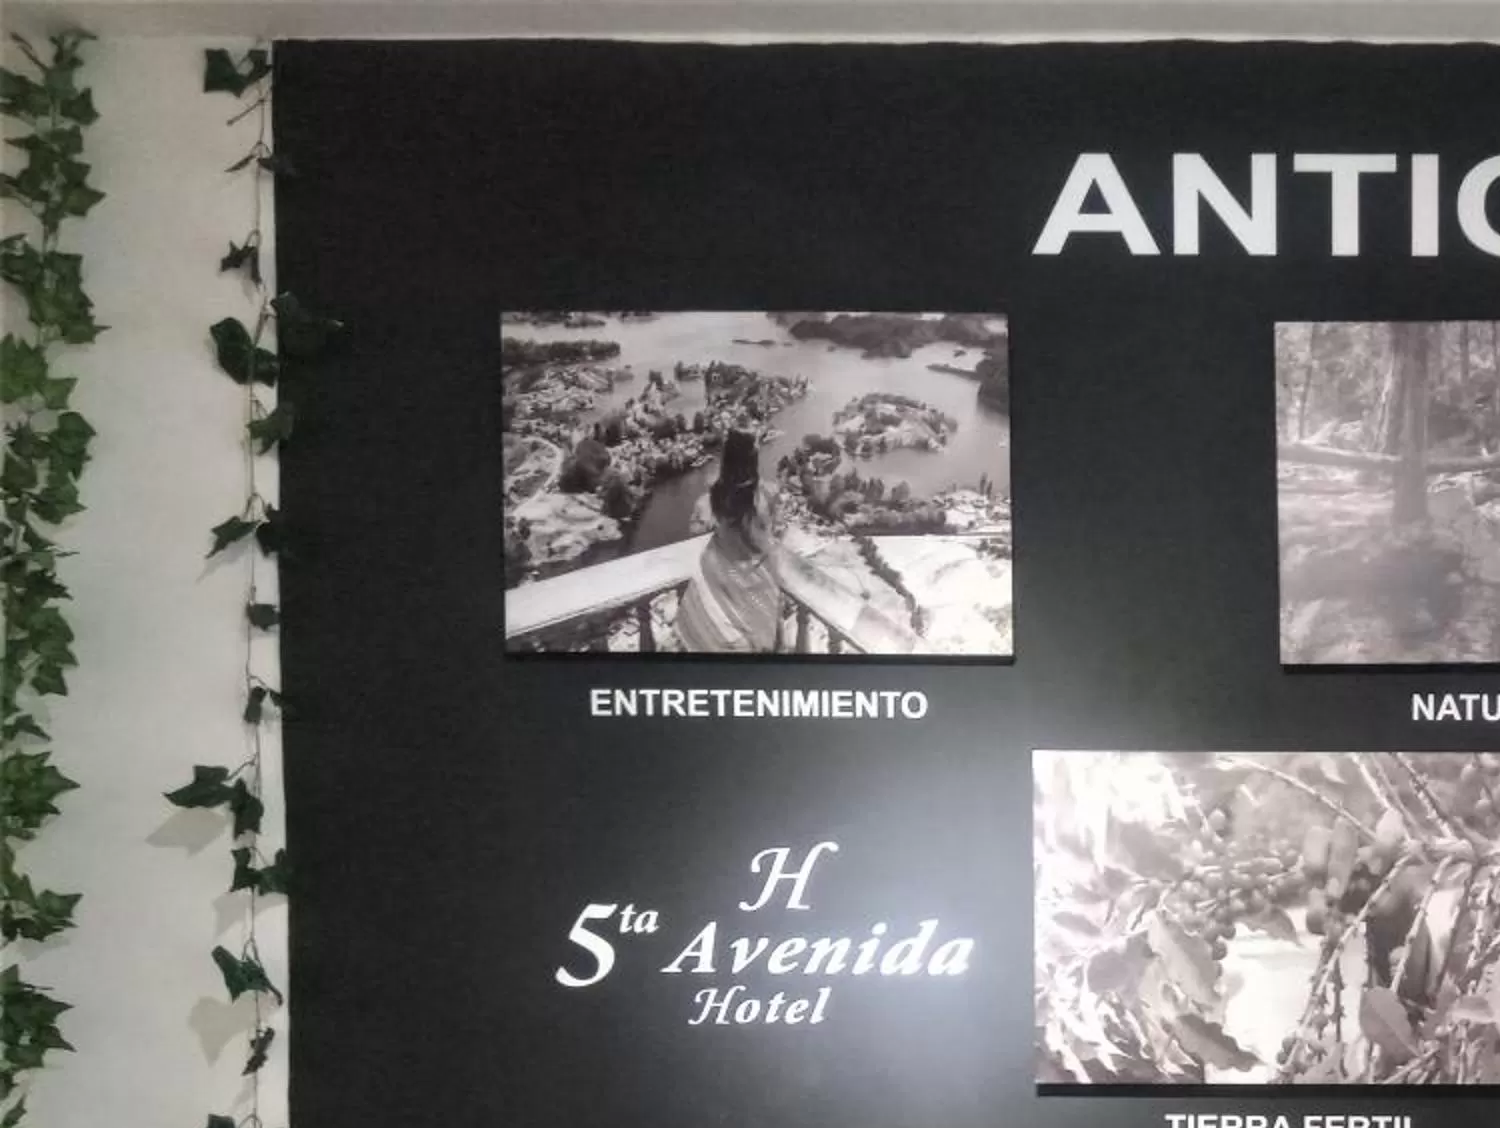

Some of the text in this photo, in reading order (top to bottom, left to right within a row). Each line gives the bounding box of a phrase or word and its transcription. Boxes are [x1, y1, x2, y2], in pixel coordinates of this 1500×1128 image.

[590, 689, 930, 719] ENTRETENIMIENTO
[738, 841, 840, 912] H
[661, 919, 976, 977] Avenida
[687, 985, 833, 1026] Hotel
